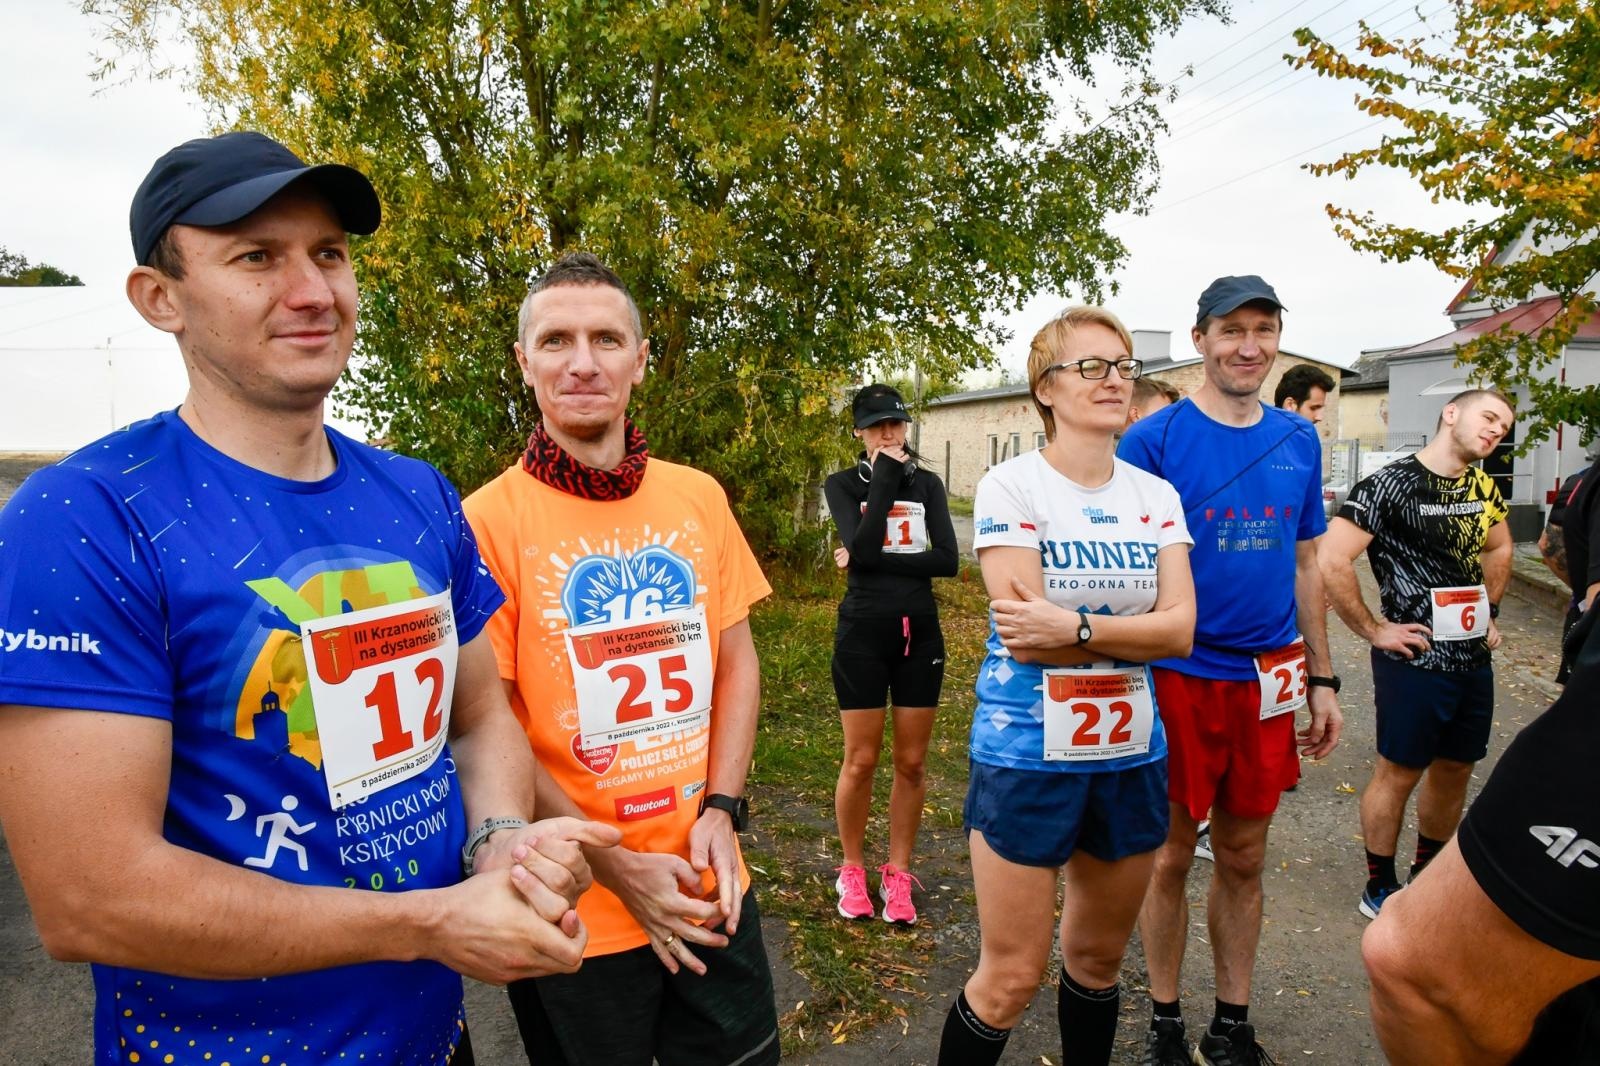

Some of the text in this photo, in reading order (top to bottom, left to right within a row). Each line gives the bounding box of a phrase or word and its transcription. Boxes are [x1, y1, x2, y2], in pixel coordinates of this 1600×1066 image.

[1049, 579, 1158, 590] EKO-OKNA TEA
[354, 630, 368, 645] III
[371, 611, 442, 641] Krzanowicki
[603, 621, 701, 645] III Krzanowicki bieg
[1461, 605, 1476, 632] 6
[0, 628, 101, 654] ybnik
[360, 647, 378, 660] na
[381, 631, 437, 656] dystansie
[608, 632, 702, 656] na dystansie 10 km
[607, 654, 694, 724] 25
[1273, 661, 1308, 705] 23
[364, 657, 444, 762] 12
[1070, 700, 1133, 746] 22
[656, 722, 670, 730] 2022
[596, 770, 644, 790] BIEGAMY
[645, 768, 655, 779] W
[657, 760, 688, 776] POLSCE
[620, 752, 661, 771] POLICZ
[361, 779, 368, 788] 8
[336, 793, 421, 837] RYBNICKI
[623, 797, 670, 816] Dawtona
[340, 808, 448, 866] KSIĘŻYCOWY
[1529, 825, 1600, 868] 4F
[344, 859, 419, 890] 2020
